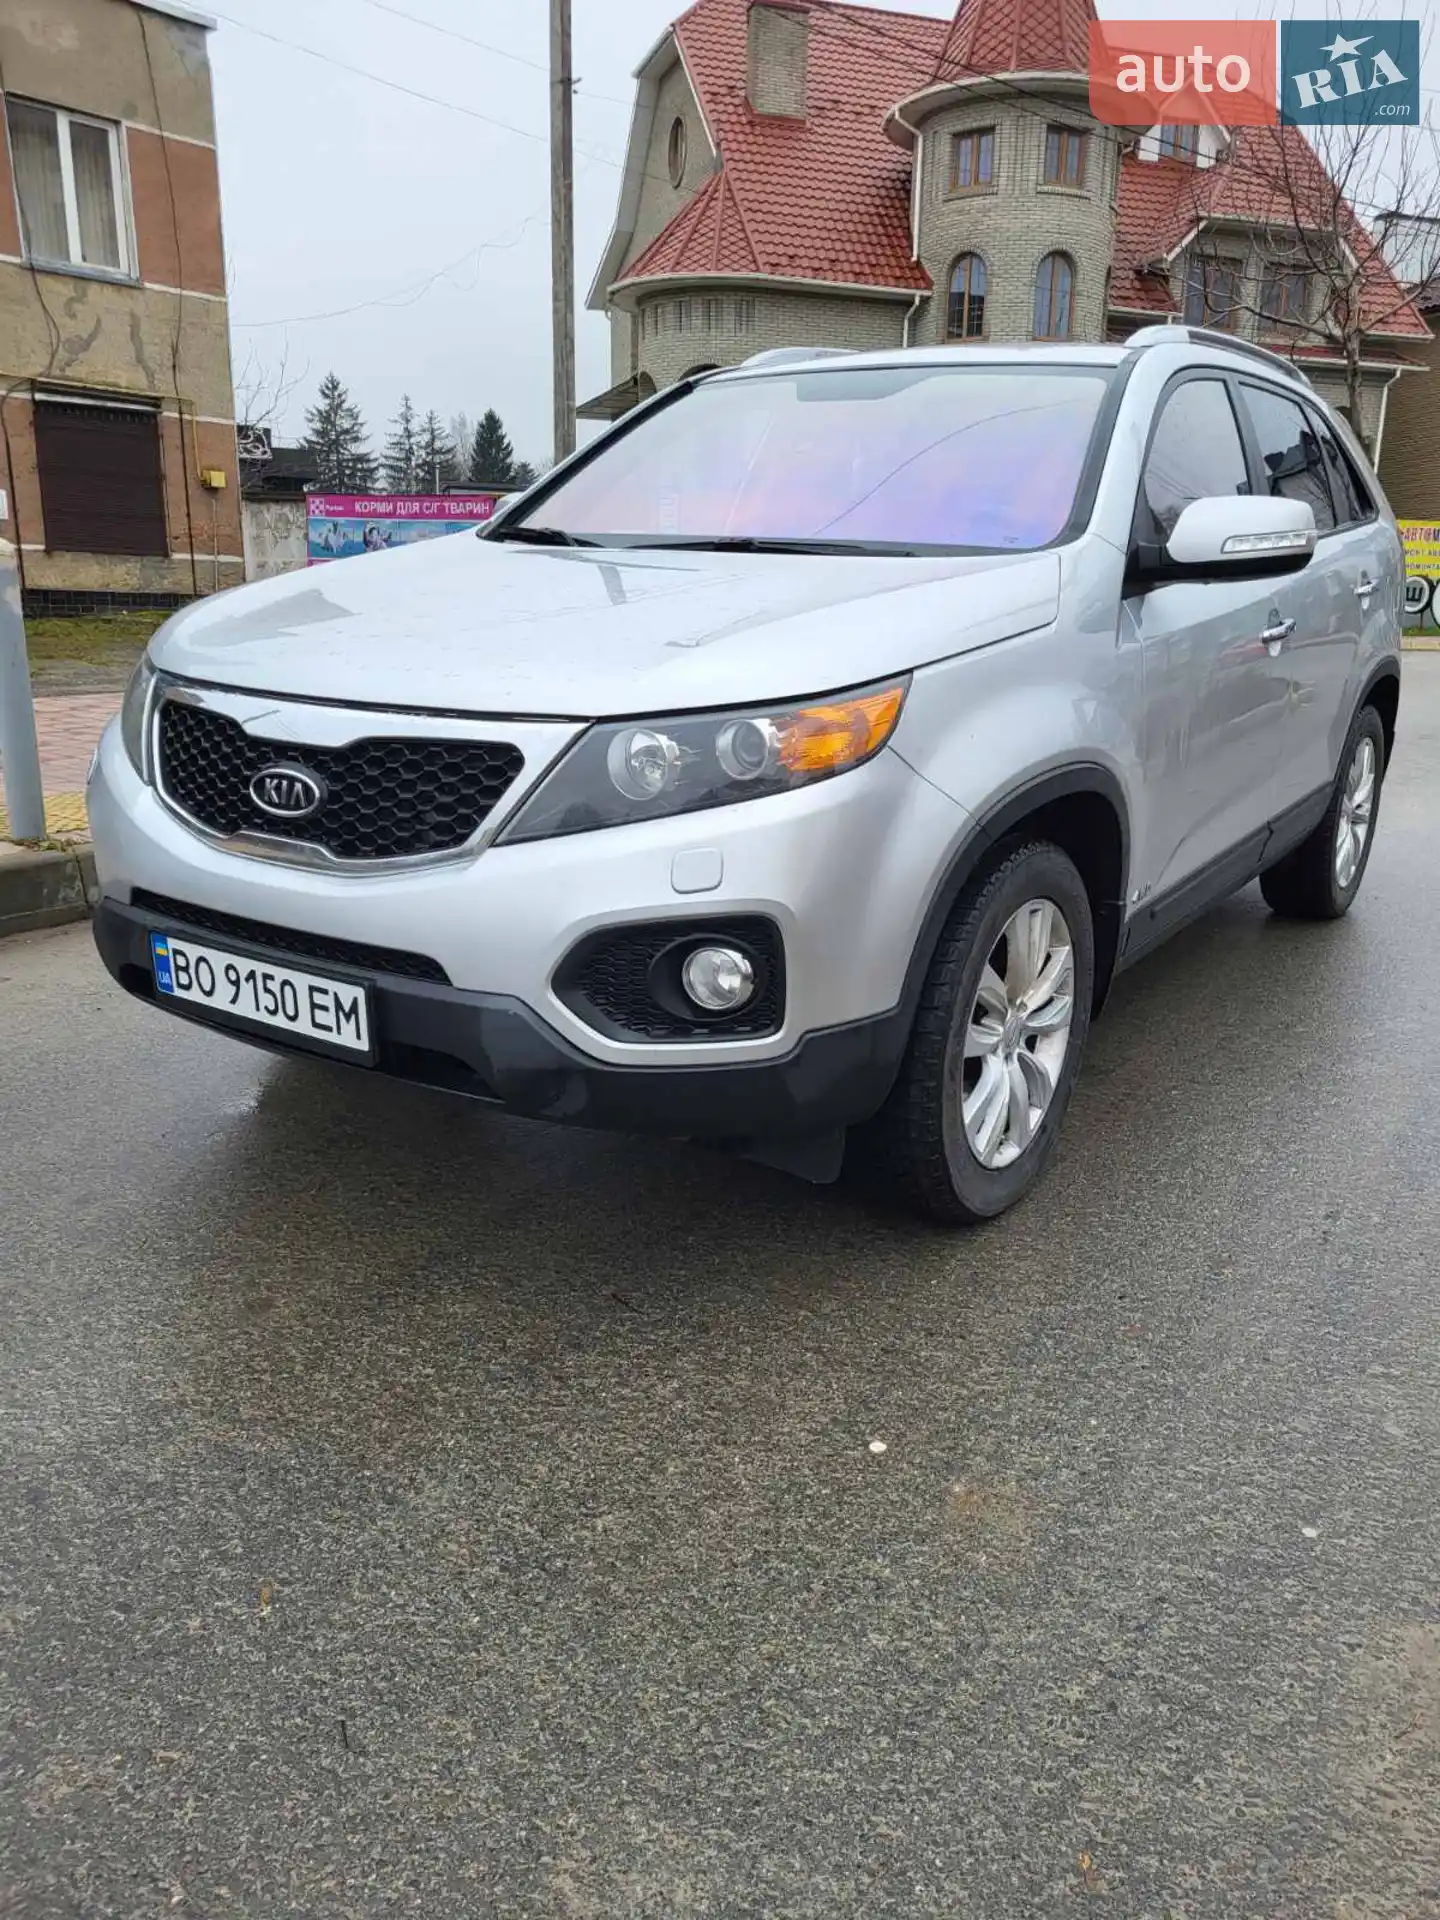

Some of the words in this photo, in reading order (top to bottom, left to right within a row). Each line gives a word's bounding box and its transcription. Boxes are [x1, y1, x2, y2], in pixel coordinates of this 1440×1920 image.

[354, 501, 394, 514] КОРМИ
[395, 501, 420, 515] ДЛЯ
[423, 501, 441, 514] С/Г
[443, 502, 490, 515] ТВАРИН
[263, 777, 306, 808] KIA
[158, 970, 172, 985] UA
[171, 947, 216, 998] BO
[223, 963, 300, 1023] 9150
[307, 984, 362, 1041] EM
